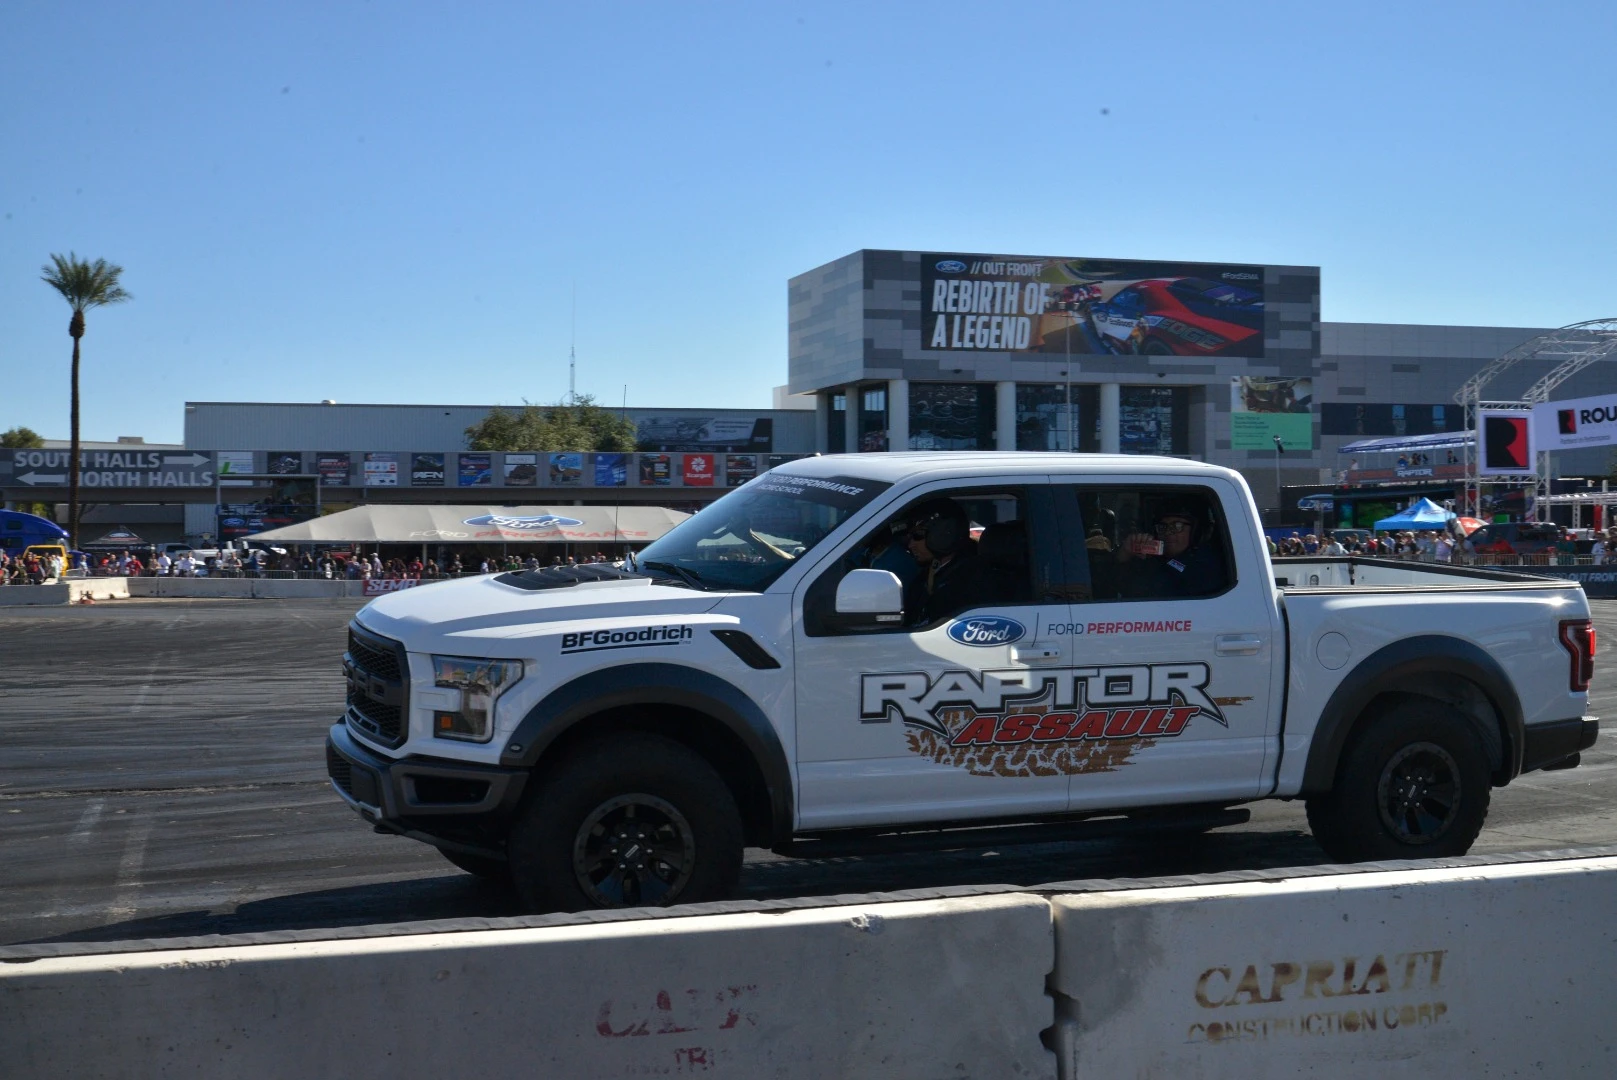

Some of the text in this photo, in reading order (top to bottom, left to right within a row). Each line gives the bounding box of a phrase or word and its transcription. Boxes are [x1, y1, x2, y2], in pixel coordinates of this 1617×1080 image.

[982, 262, 1005, 275] OUT
[1007, 263, 1042, 276] FRONT
[932, 279, 1051, 315] REBIRTH OF
[931, 314, 1031, 350] A LEGEND
[1160, 317, 1225, 350] EDGE
[15, 451, 160, 469] SOUTH HALLS
[149, 471, 213, 487] HALLS
[487, 514, 560, 529] Ford
[473, 530, 648, 538] PERFORMANCE
[561, 625, 693, 649] BFGoodrich
[1047, 620, 1192, 636] FORD PERFORMANCE
[859, 660, 1229, 740] RAPTOR
[950, 706, 1201, 746] ASSAULT
